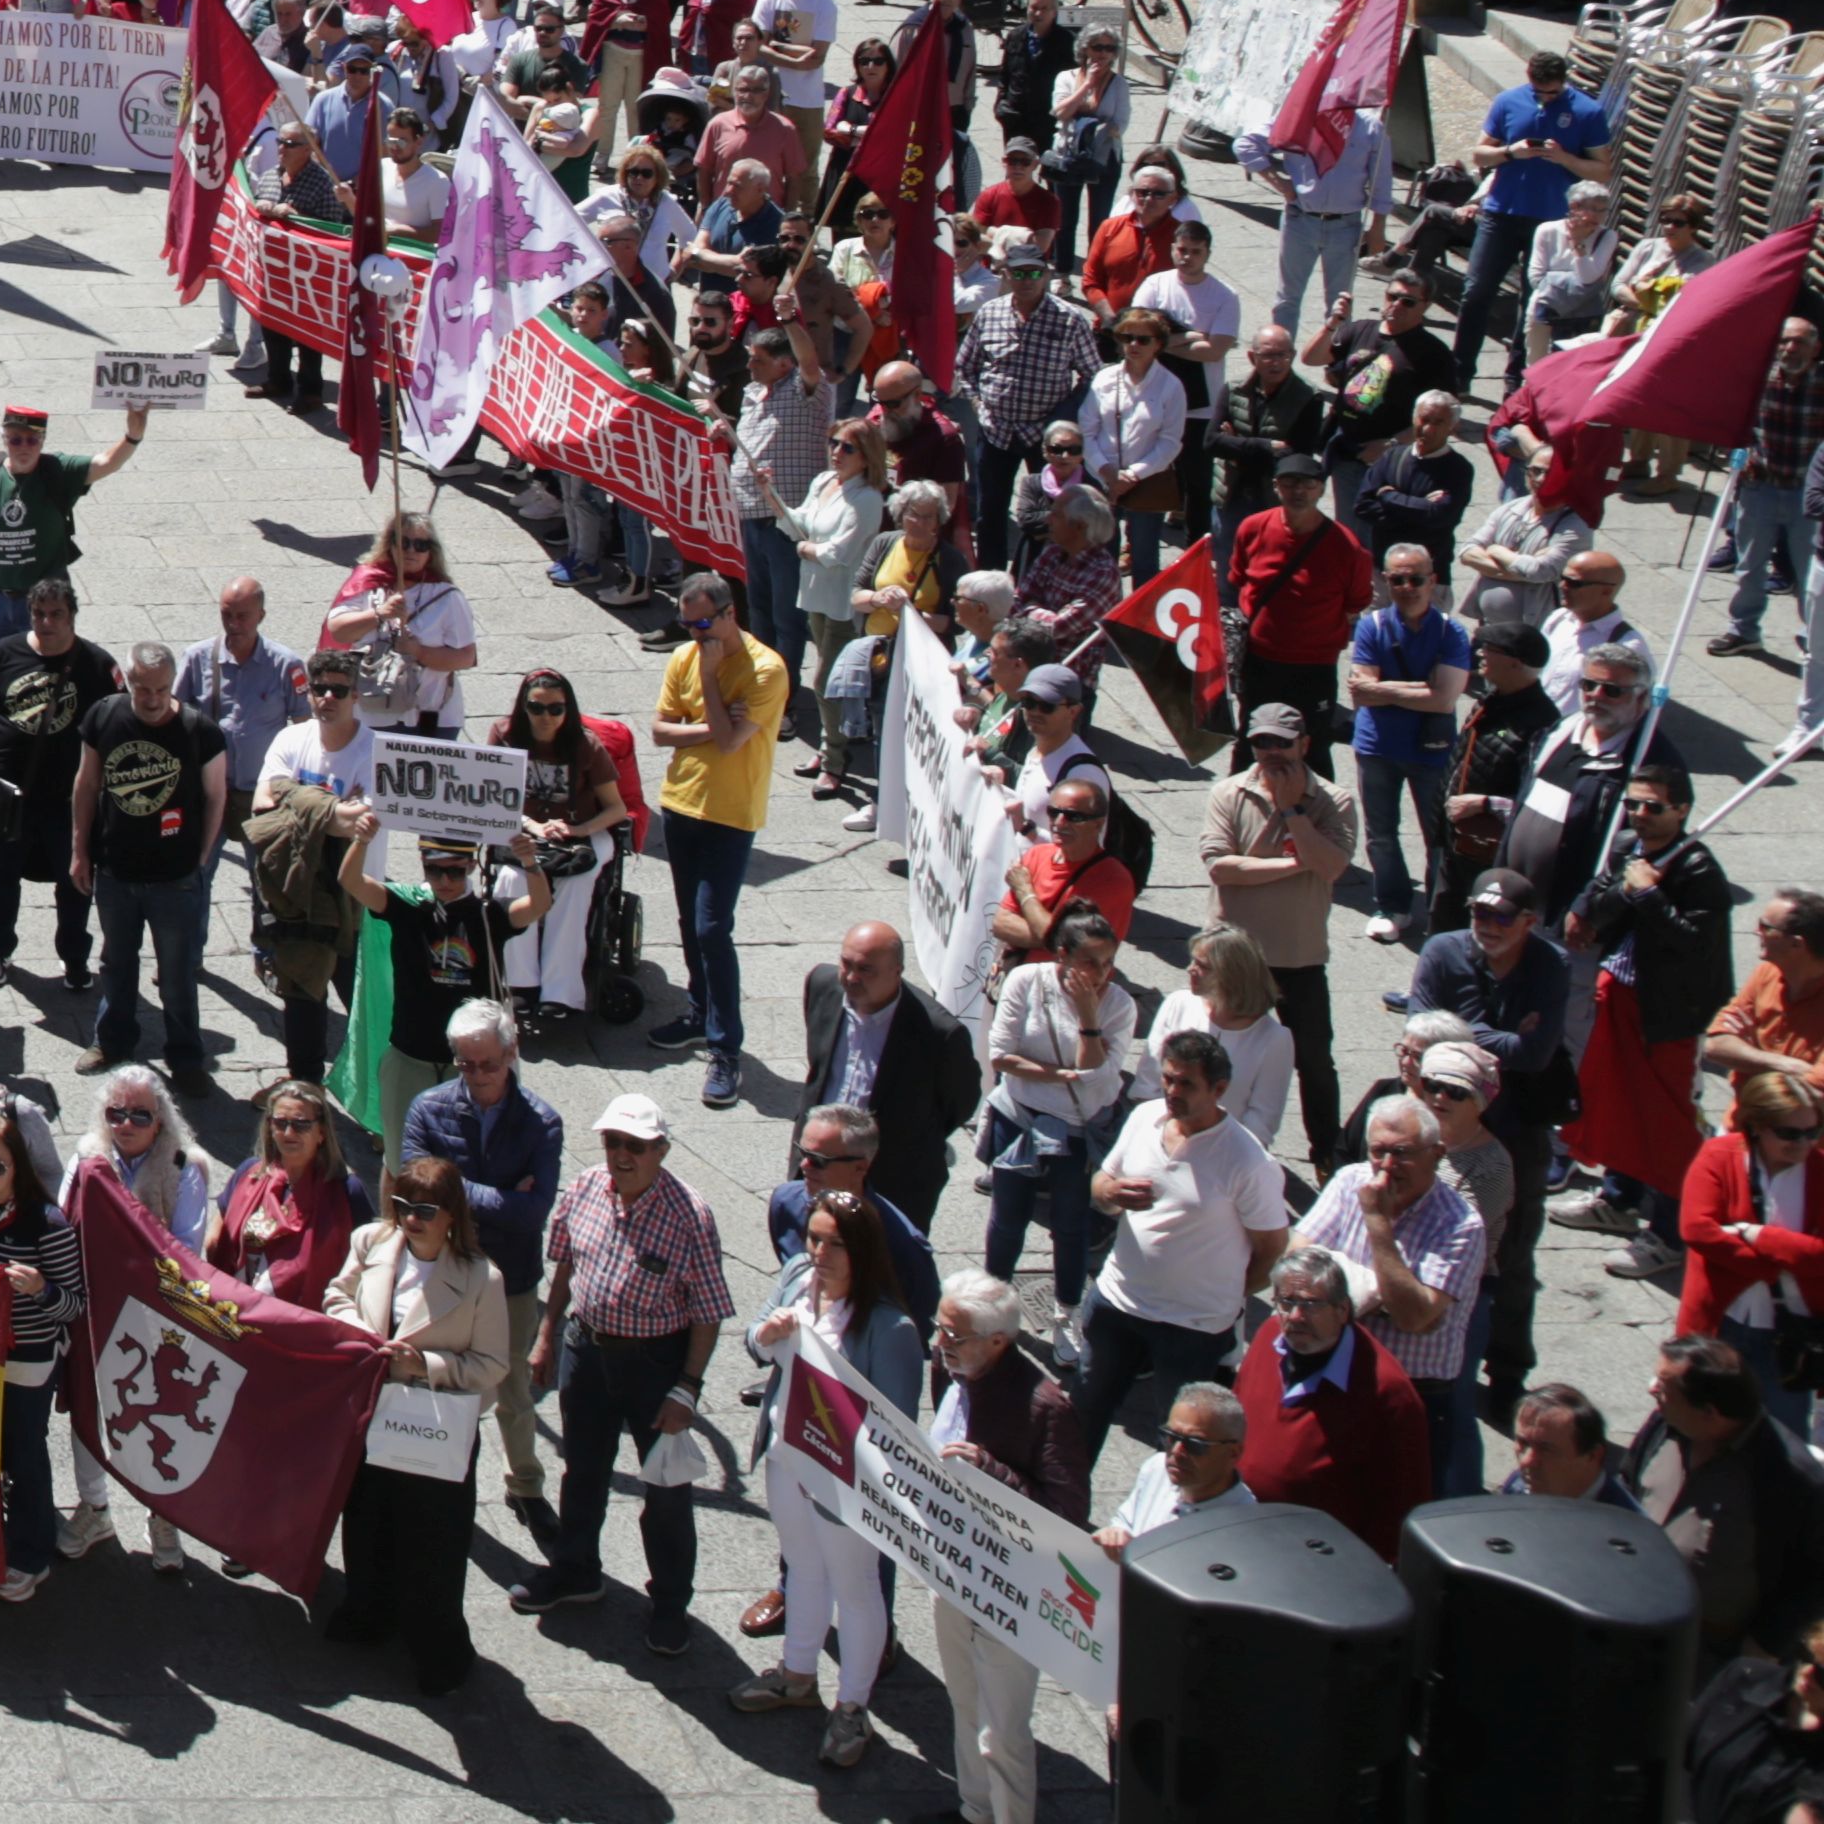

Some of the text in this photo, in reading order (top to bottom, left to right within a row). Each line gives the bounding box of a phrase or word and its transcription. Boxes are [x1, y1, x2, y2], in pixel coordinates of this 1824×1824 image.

[59, 24, 93, 50] POR
[98, 27, 117, 52] EL
[122, 29, 166, 57] TREN
[2, 58, 27, 84] DE
[31, 60, 53, 86] LA
[58, 60, 120, 90] PLATA!
[49, 93, 79, 120] POR
[28, 126, 97, 157] FUTURO!
[95, 361, 143, 388] NO
[147, 369, 206, 389] MURO
[385, 741, 467, 760] NAVALMORAL
[375, 758, 459, 800] NO AL
[443, 779, 520, 812] MURO
[384, 1419, 449, 1442] MANGO
[802, 1428, 844, 1467] Cáceres
[867, 1427, 1035, 1553] LUCHANDO LO
[882, 1470, 1011, 1566] QUE NOS UNE
[859, 1479, 1029, 1611] REAPERTURA TREN
[861, 1507, 1019, 1637] RUTA DE LA PLATA
